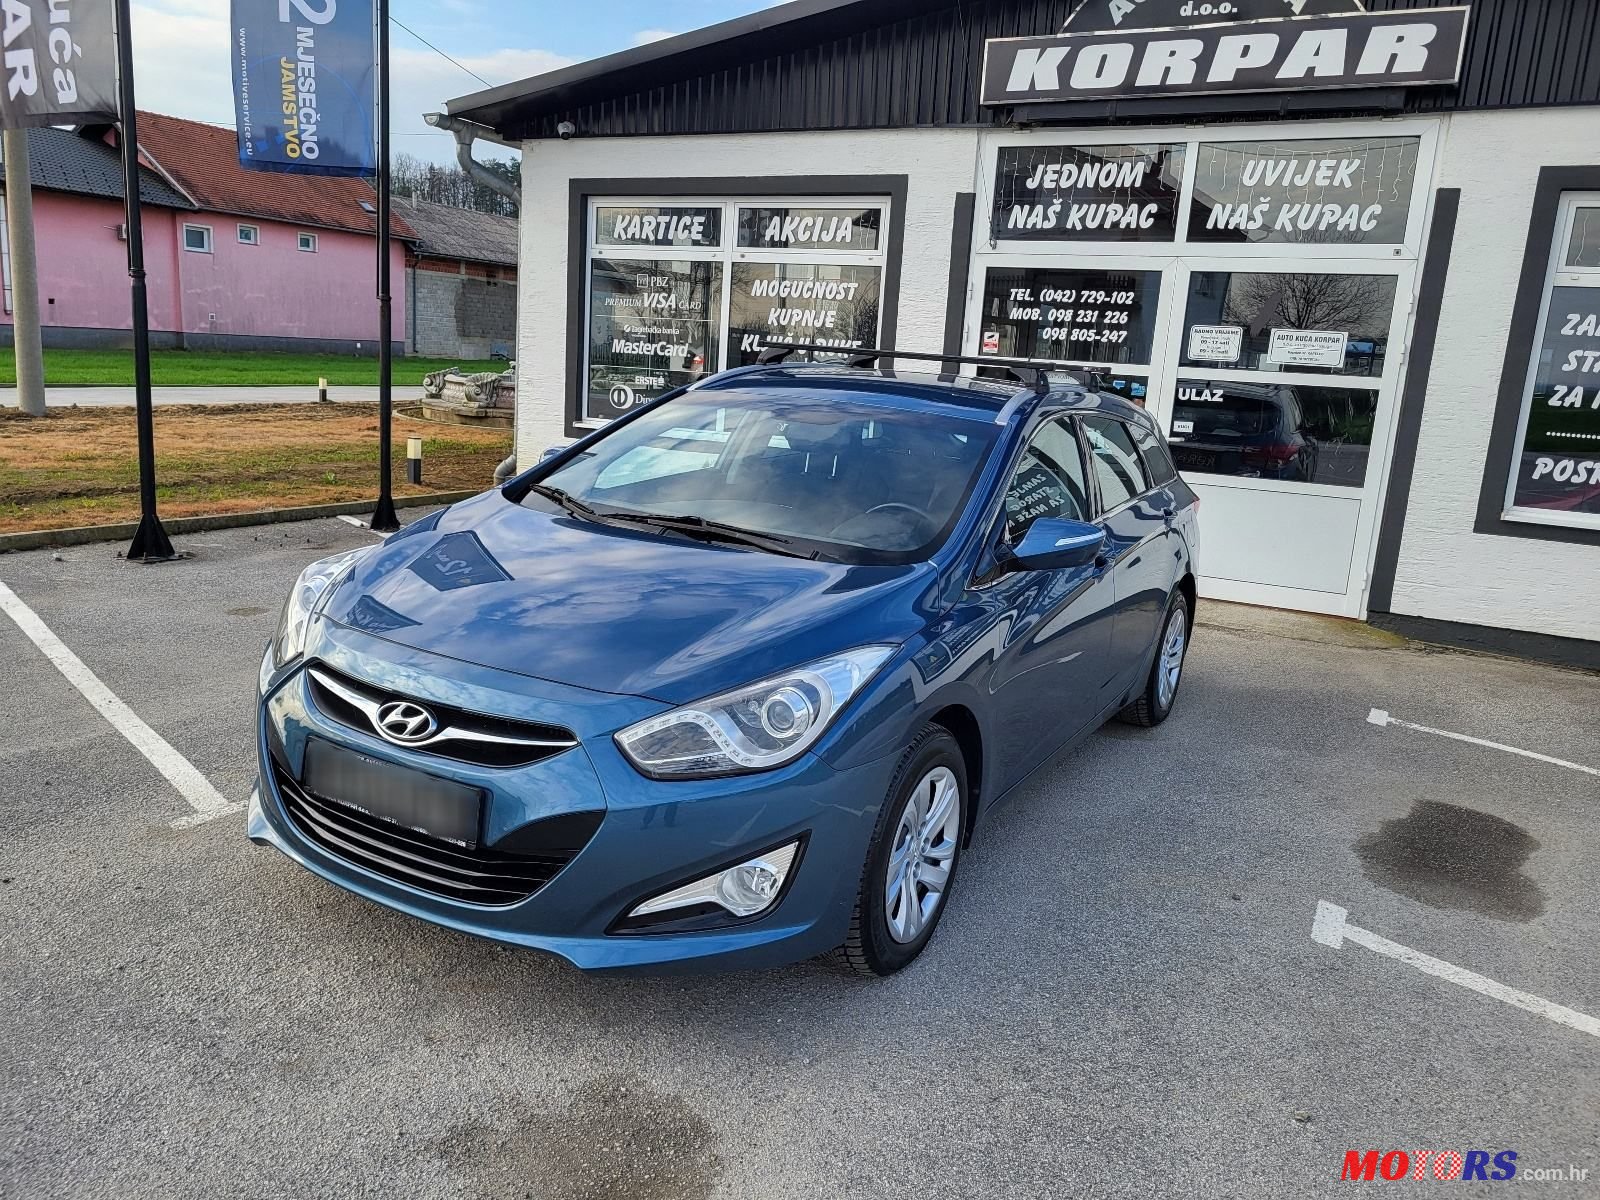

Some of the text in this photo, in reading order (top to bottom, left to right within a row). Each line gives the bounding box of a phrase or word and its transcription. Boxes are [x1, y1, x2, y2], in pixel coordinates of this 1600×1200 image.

[1179, 1, 1238, 17] d.o.o.
[1005, 22, 1438, 92] KORPAR
[239, 27, 253, 156] www.motiveservice.eu
[296, 26, 321, 160] MJESEČNO
[280, 56, 301, 159] JAMSTVO
[1025, 162, 1145, 189] JEDNOM
[1242, 159, 1361, 188] UVIJEK
[1007, 198, 1158, 231] NAŠ KUPAC
[1205, 196, 1383, 232] NAŠ KUPAC
[612, 214, 706, 241] KARTICE
[764, 215, 853, 243] AKCIJA
[650, 276, 669, 287] PBZ
[750, 276, 859, 301] MOGUĆNOST
[604, 292, 702, 310] PREMIUM VISA CARD
[1009, 288, 1135, 305] TEL. (042) 729-102
[767, 307, 837, 328] KUPNJE
[1047, 308, 1074, 322] 098
[1075, 310, 1099, 323] 231
[1103, 311, 1129, 324] 226
[1560, 313, 1600, 337] ZA
[1042, 327, 1128, 343] 098 805-247
[1314, 336, 1341, 344] KORPAR
[635, 375, 658, 386] ERSTE
[1178, 387, 1224, 402] ULAZ
[1548, 384, 1584, 408] ZA
